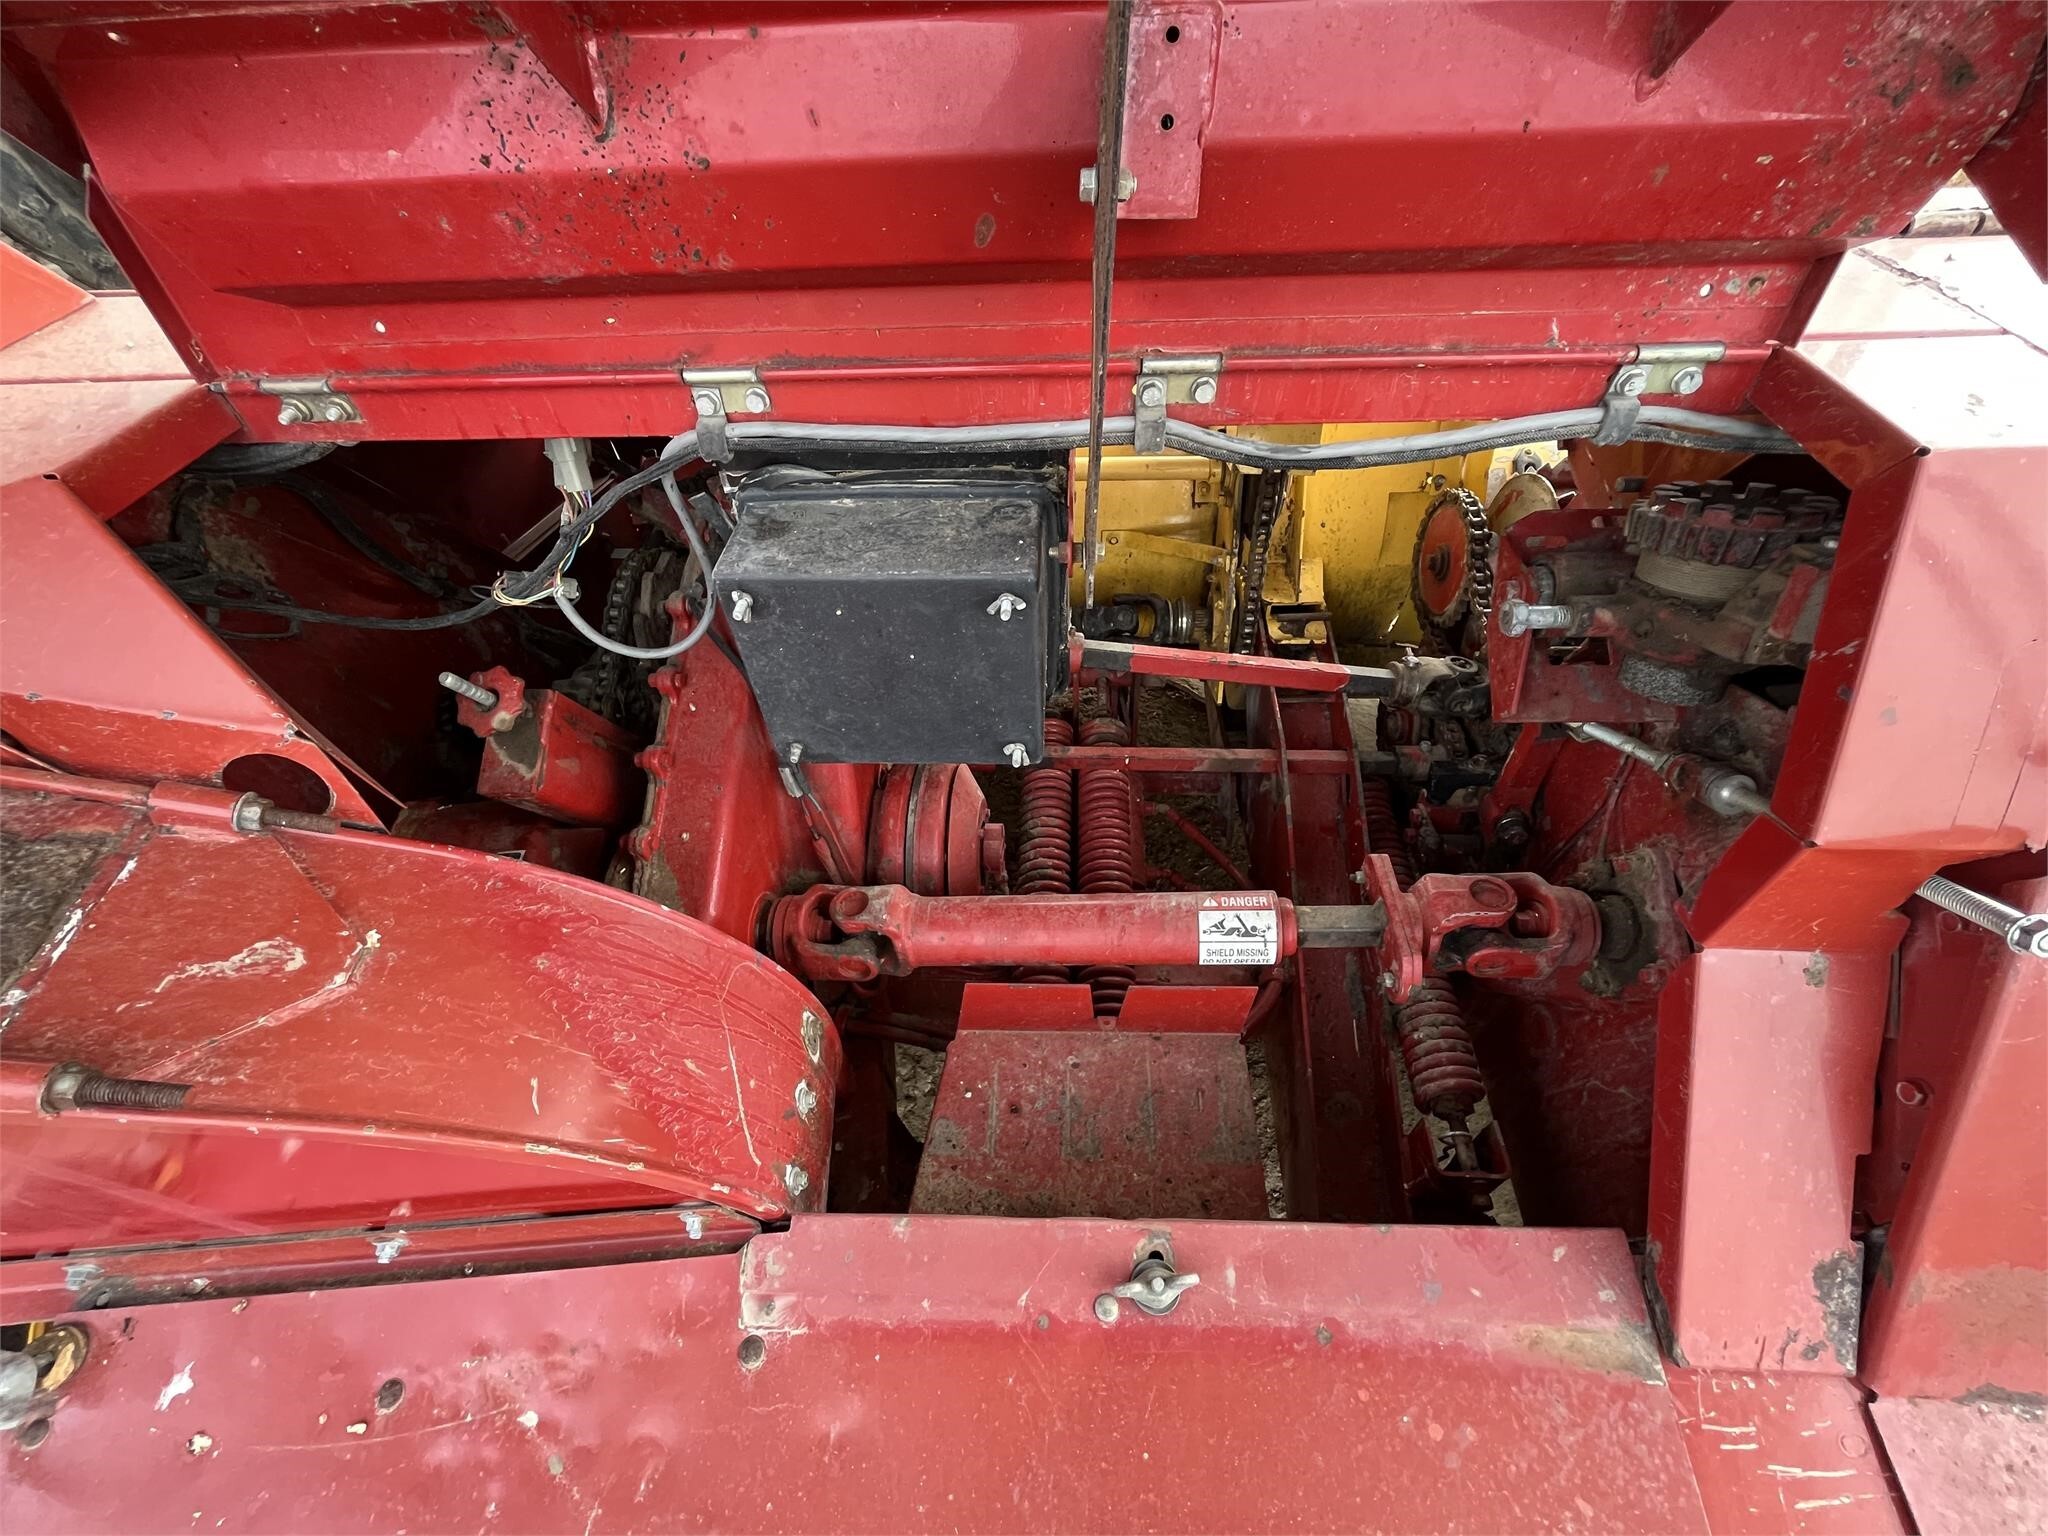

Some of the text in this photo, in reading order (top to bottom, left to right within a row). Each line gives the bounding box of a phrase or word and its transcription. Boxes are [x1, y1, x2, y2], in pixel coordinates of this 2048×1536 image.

[1220, 896, 1268, 907] DANGER
[1206, 948, 1269, 957] SHIELD MISSING
